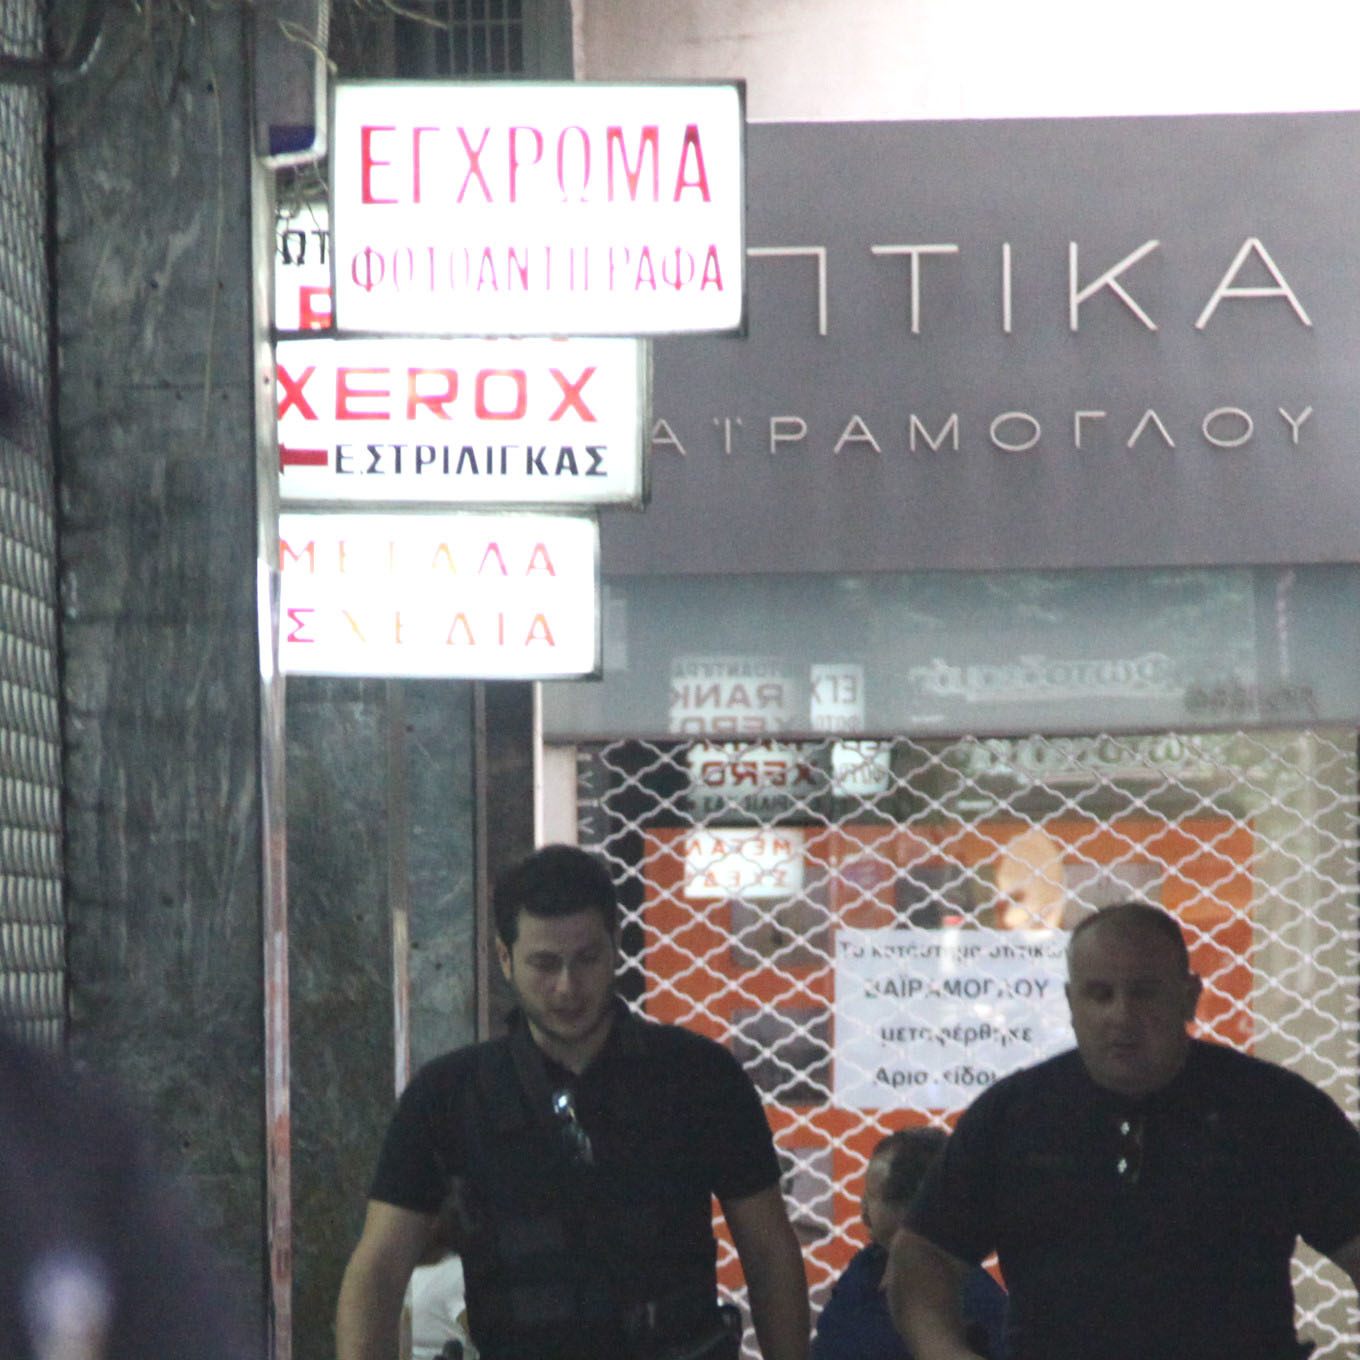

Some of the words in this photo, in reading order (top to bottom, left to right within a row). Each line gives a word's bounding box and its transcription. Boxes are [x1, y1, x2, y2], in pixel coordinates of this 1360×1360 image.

[360, 123, 712, 205] ΕΓΧΡΩΜΑ
[746, 236, 1313, 336] ΠΤΙΚΑ
[277, 363, 599, 423] XEROX
[651, 404, 1314, 457] ΑΪΡΑΜΟΓΛΟΥ
